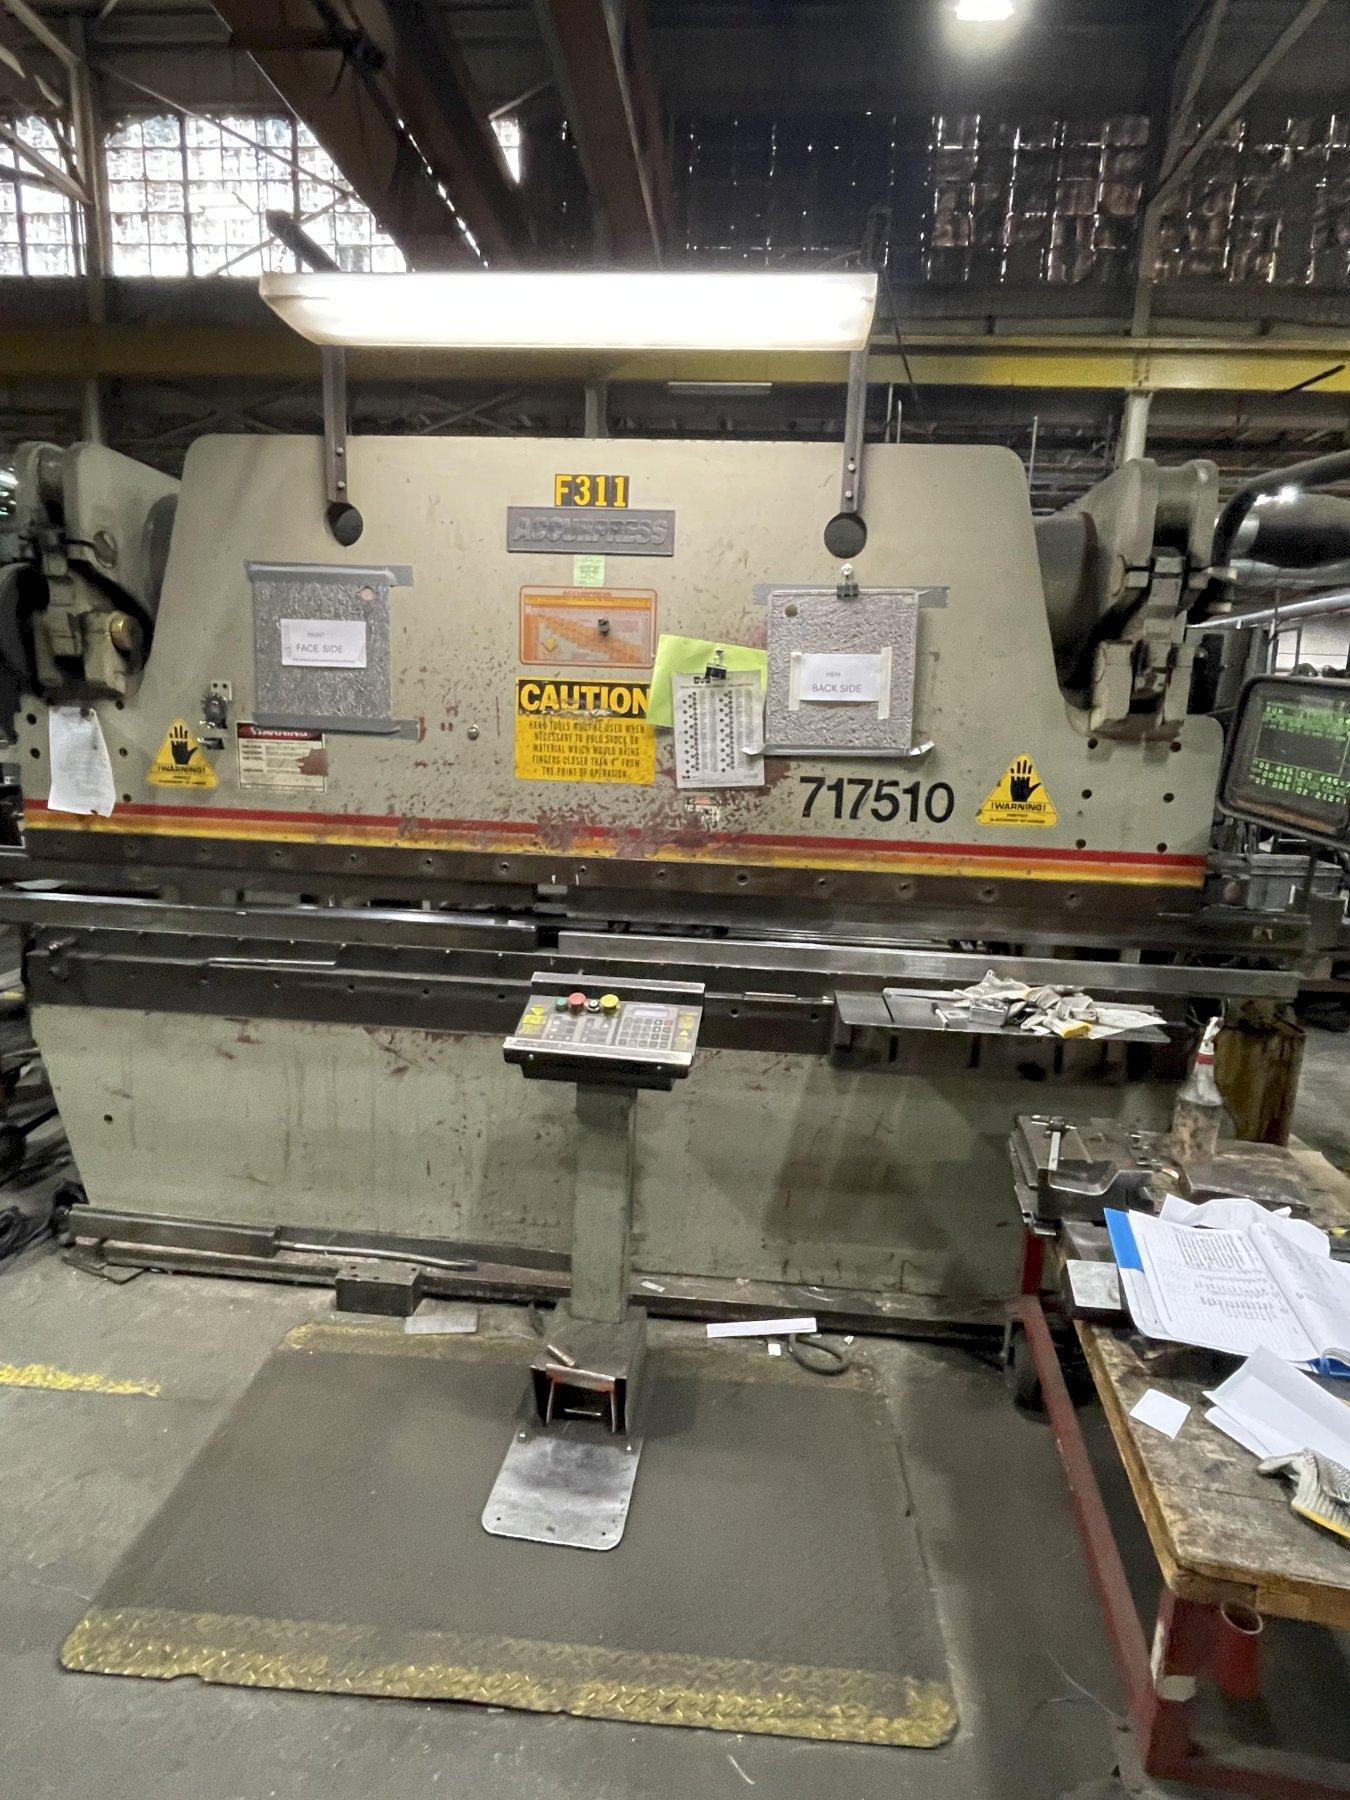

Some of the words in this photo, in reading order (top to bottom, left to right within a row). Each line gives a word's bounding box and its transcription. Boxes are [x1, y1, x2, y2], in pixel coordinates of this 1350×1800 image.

[555, 475, 626, 507] F311
[296, 643, 319, 653] FACE
[322, 645, 343, 654] SIDE
[520, 683, 650, 714] CAUTION
[812, 683, 837, 692] BACK
[840, 684, 862, 693] SIDE
[799, 776, 955, 824] 717510
